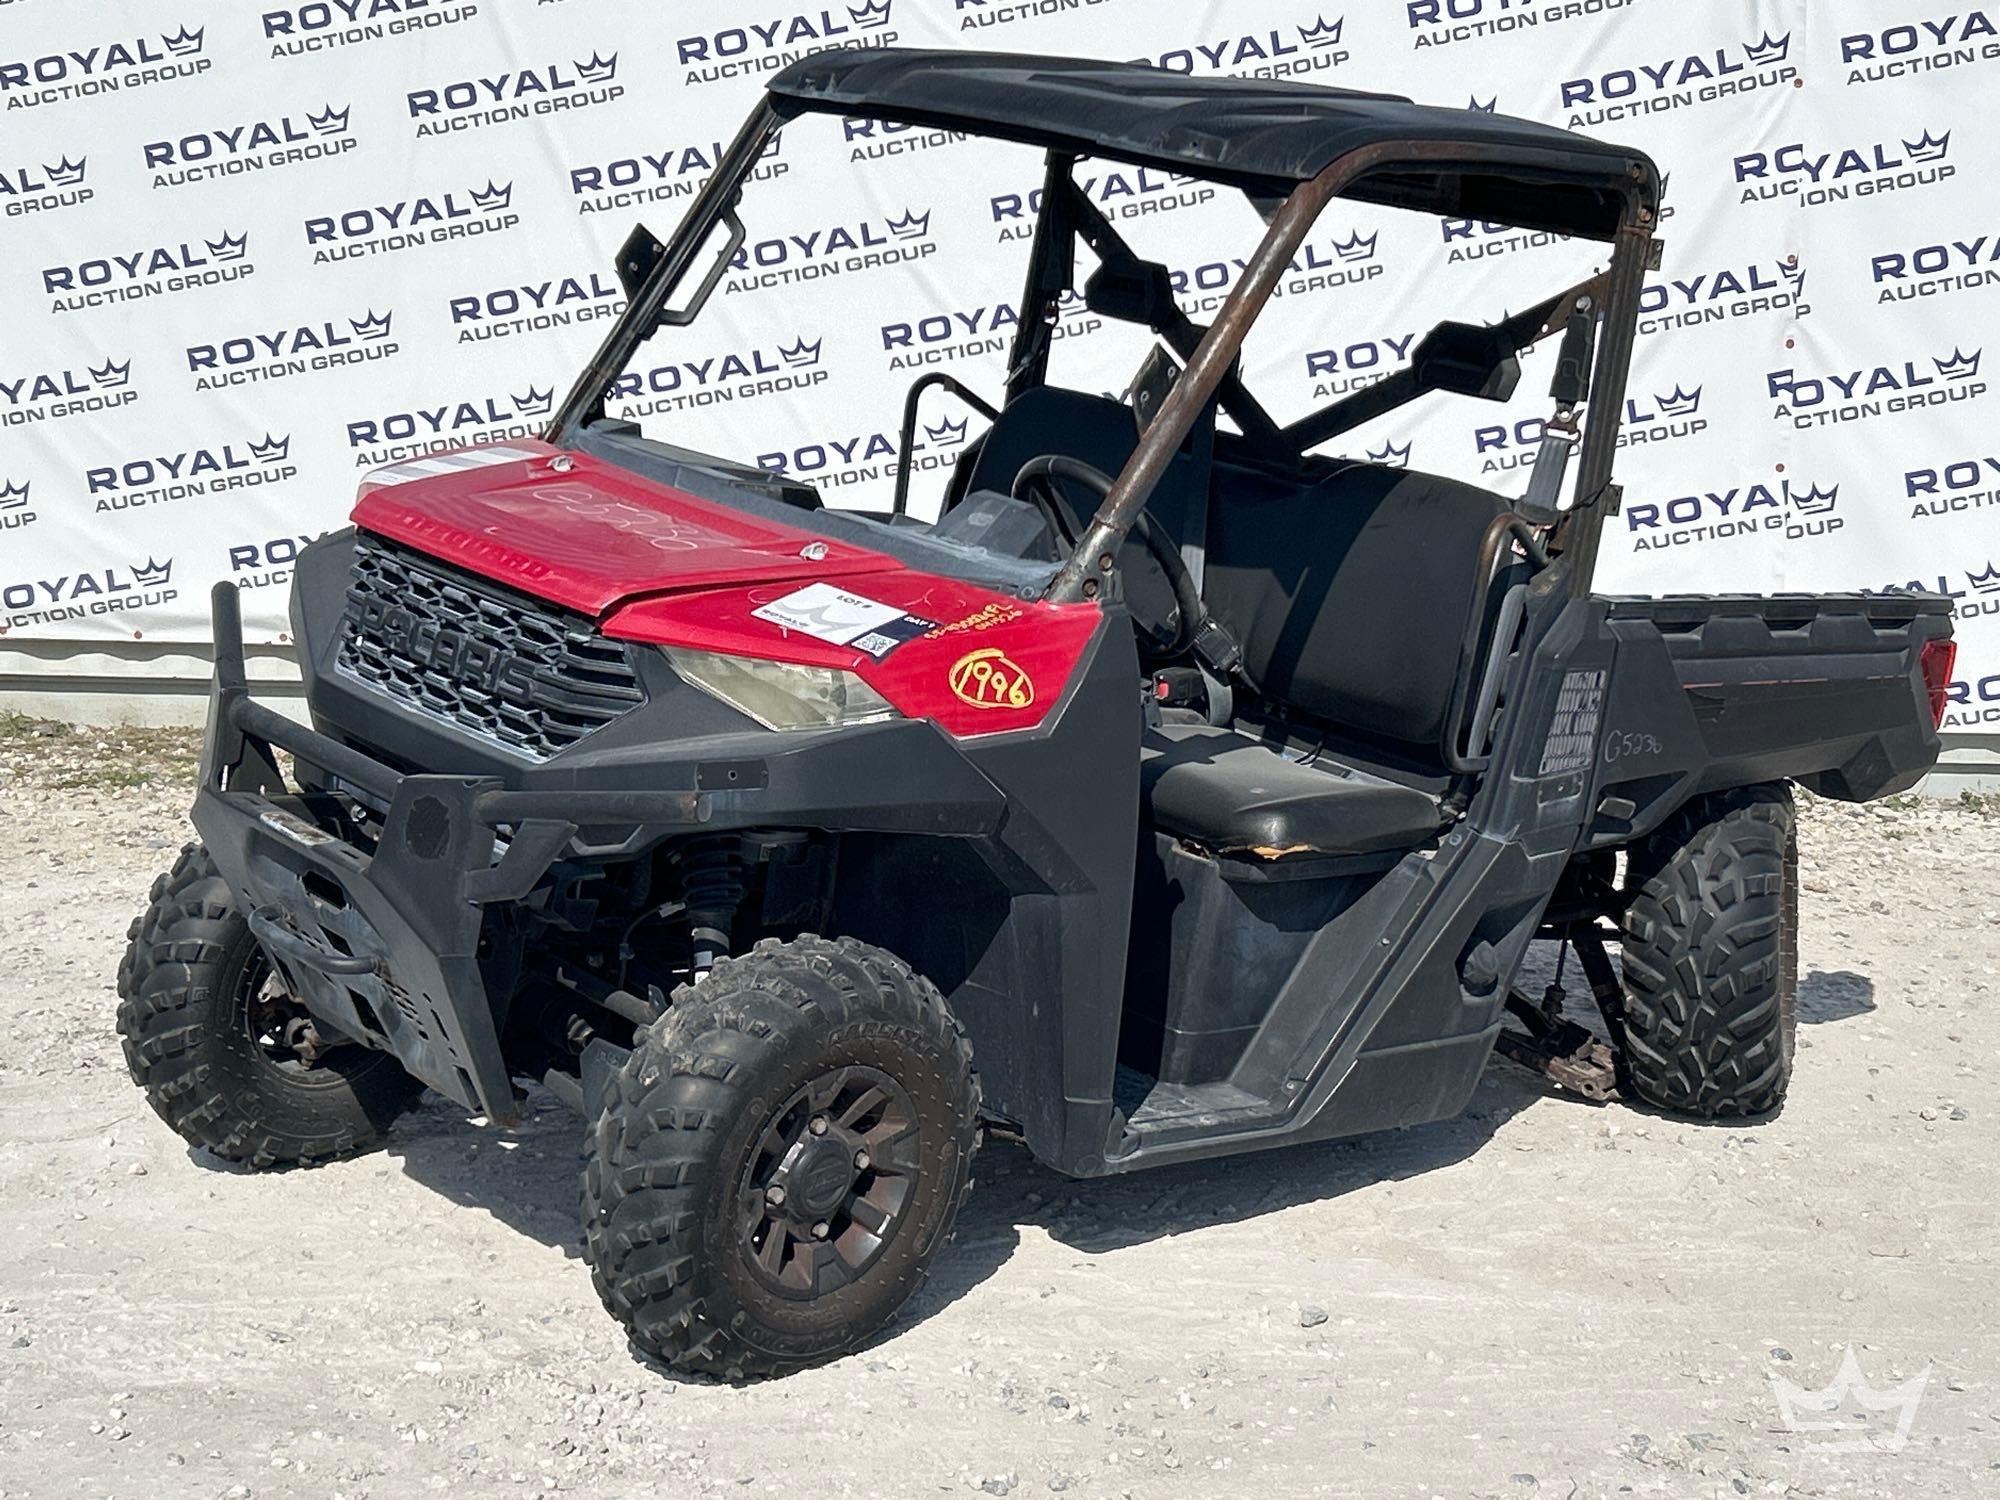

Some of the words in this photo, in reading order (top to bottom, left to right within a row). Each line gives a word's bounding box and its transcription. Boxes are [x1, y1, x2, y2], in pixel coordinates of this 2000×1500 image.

[271, 25, 383, 59] AUCTION
[389, 5, 477, 34] GROUP
[677, 11, 848, 65] ROYAL
[961, 0, 1079, 31] AUCTION
[1414, 11, 1538, 49] AUCTION
[1841, 12, 1998, 63] ROYA
[0, 39, 163, 90] ROYAL
[685, 49, 799, 86] AUCTION
[1160, 30, 1298, 75] OYAL
[1254, 50, 1349, 79] GROUP
[1847, 48, 1974, 85] AUCTION
[7, 77, 119, 110] AUCTION
[124, 59, 211, 87] GROUP
[407, 65, 575, 117] ROYAL
[1561, 49, 1744, 108] ROYAL
[1568, 92, 1692, 129] AUCTION
[1699, 67, 1796, 101] GROUP
[417, 104, 528, 138] AUCTION
[534, 86, 624, 114] GROUP
[144, 118, 308, 169] ROYAL
[153, 156, 263, 189] AUCTION
[269, 138, 357, 166] GROUP
[6, 189, 93, 216] GROUP
[580, 181, 692, 214] AUCTION
[1122, 189, 1214, 218] GROUP
[1741, 180, 1848, 207] AUCION
[1856, 166, 1955, 196] GROUP
[305, 194, 471, 244] ROYAL
[314, 232, 425, 264] AUCTION
[431, 215, 519, 242] GROUP
[42, 244, 207, 293] ROYAL
[726, 261, 839, 294] AUCTION
[846, 243, 936, 271] GROUP
[1289, 265, 1383, 294] GROUP
[1872, 236, 2000, 283] ROY
[52, 281, 162, 313] AUCTION
[168, 264, 254, 291] GROUP
[450, 274, 616, 323] ROYAL
[1638, 265, 1777, 313] OYAL
[458, 312, 570, 343] AUCTION
[577, 301, 628, 322] GRO
[881, 303, 1019, 350] ROYA
[1639, 305, 1724, 335] CTION
[187, 323, 351, 371] ROYAL
[196, 360, 305, 391] AUCTION
[312, 343, 398, 370] GROUP
[889, 336, 1004, 371] AUCTION
[1306, 333, 1415, 377] ROY
[0, 371, 90, 404] YAL
[616, 350, 779, 399] ROYAL
[621, 387, 733, 420] AUCTION
[739, 371, 827, 397] GROUP
[51, 391, 137, 417] GROUP
[347, 399, 512, 446] ROYAL
[1774, 402, 1880, 429] ACTION
[1888, 383, 1986, 412] GROUP
[87, 446, 249, 493] ROYAL
[355, 436, 467, 467] AUCTION
[96, 482, 205, 512] AUCTION
[210, 466, 296, 492] GROUP
[1911, 490, 2000, 519] AUCTI
[1634, 519, 1757, 552] AUCTION
[1765, 512, 1843, 539] GOUP
[4, 570, 131, 609] OYAL
[91, 590, 177, 614] GROUP
[956, 661, 1026, 705] 1996
